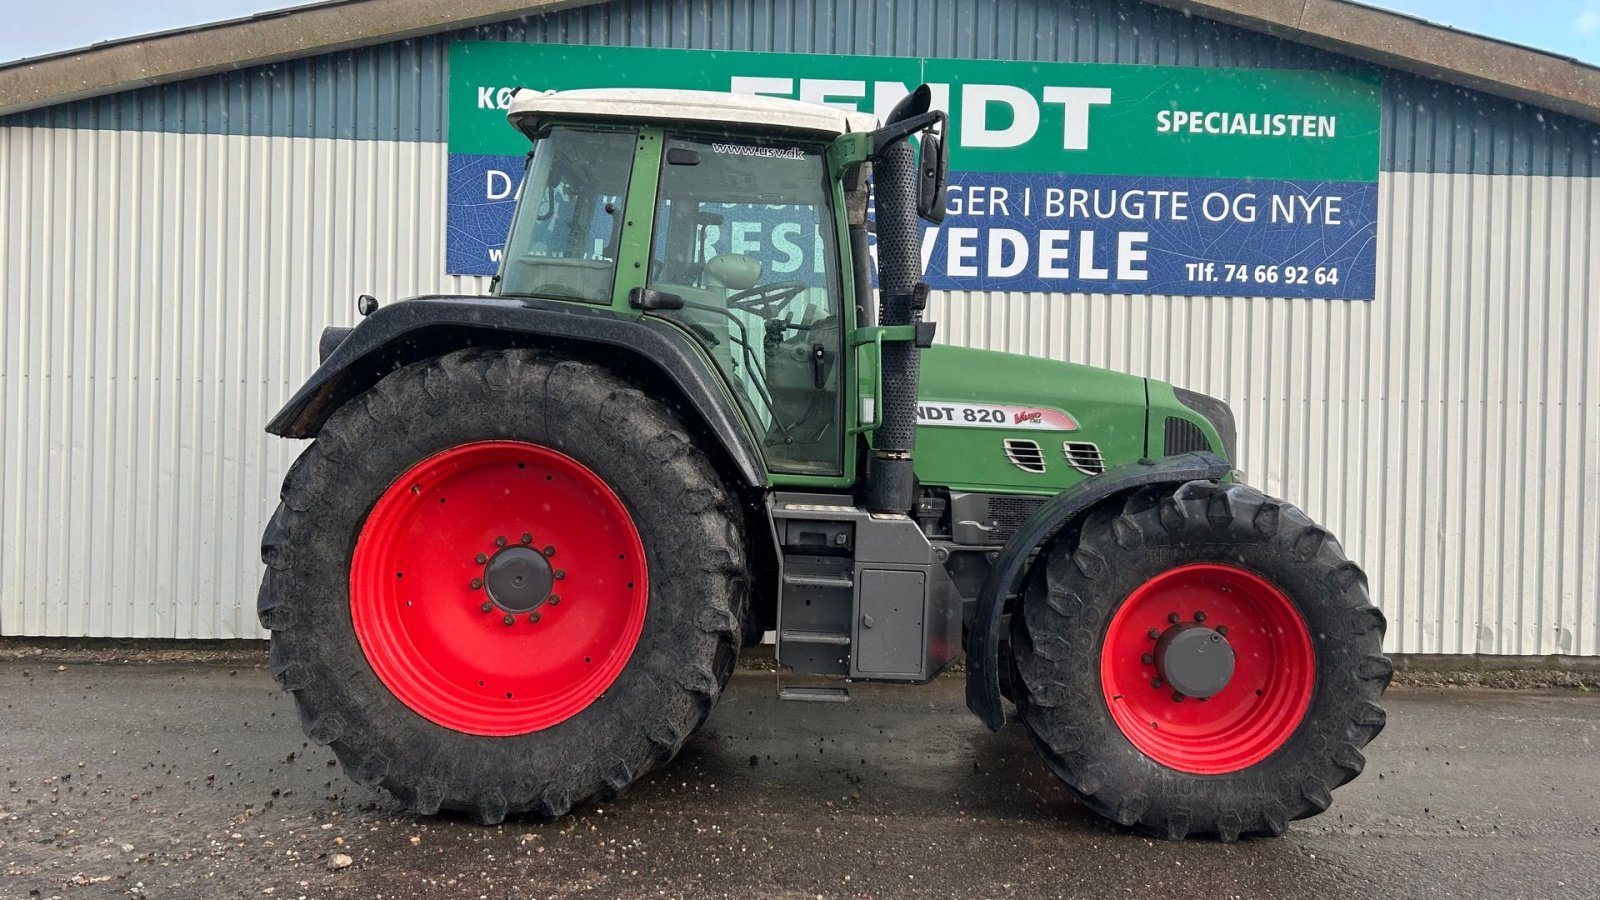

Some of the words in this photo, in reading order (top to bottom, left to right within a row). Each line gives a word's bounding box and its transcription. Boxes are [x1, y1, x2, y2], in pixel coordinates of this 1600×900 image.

[1156, 110, 1337, 137] SPECIALISTEN
[712, 143, 805, 161] www.usv.dk
[1024, 187, 1030, 217] I
[1045, 187, 1189, 221] BRUGTE
[1202, 192, 1256, 223] OG
[1271, 194, 1342, 225] NYE
[1185, 262, 1219, 282] Tlf.
[1224, 264, 1249, 283] 74
[1254, 264, 1279, 284] 66
[1284, 265, 1309, 285] 92
[1314, 266, 1339, 285] 64
[915, 406, 955, 421] NDT
[962, 408, 1006, 423] 820
